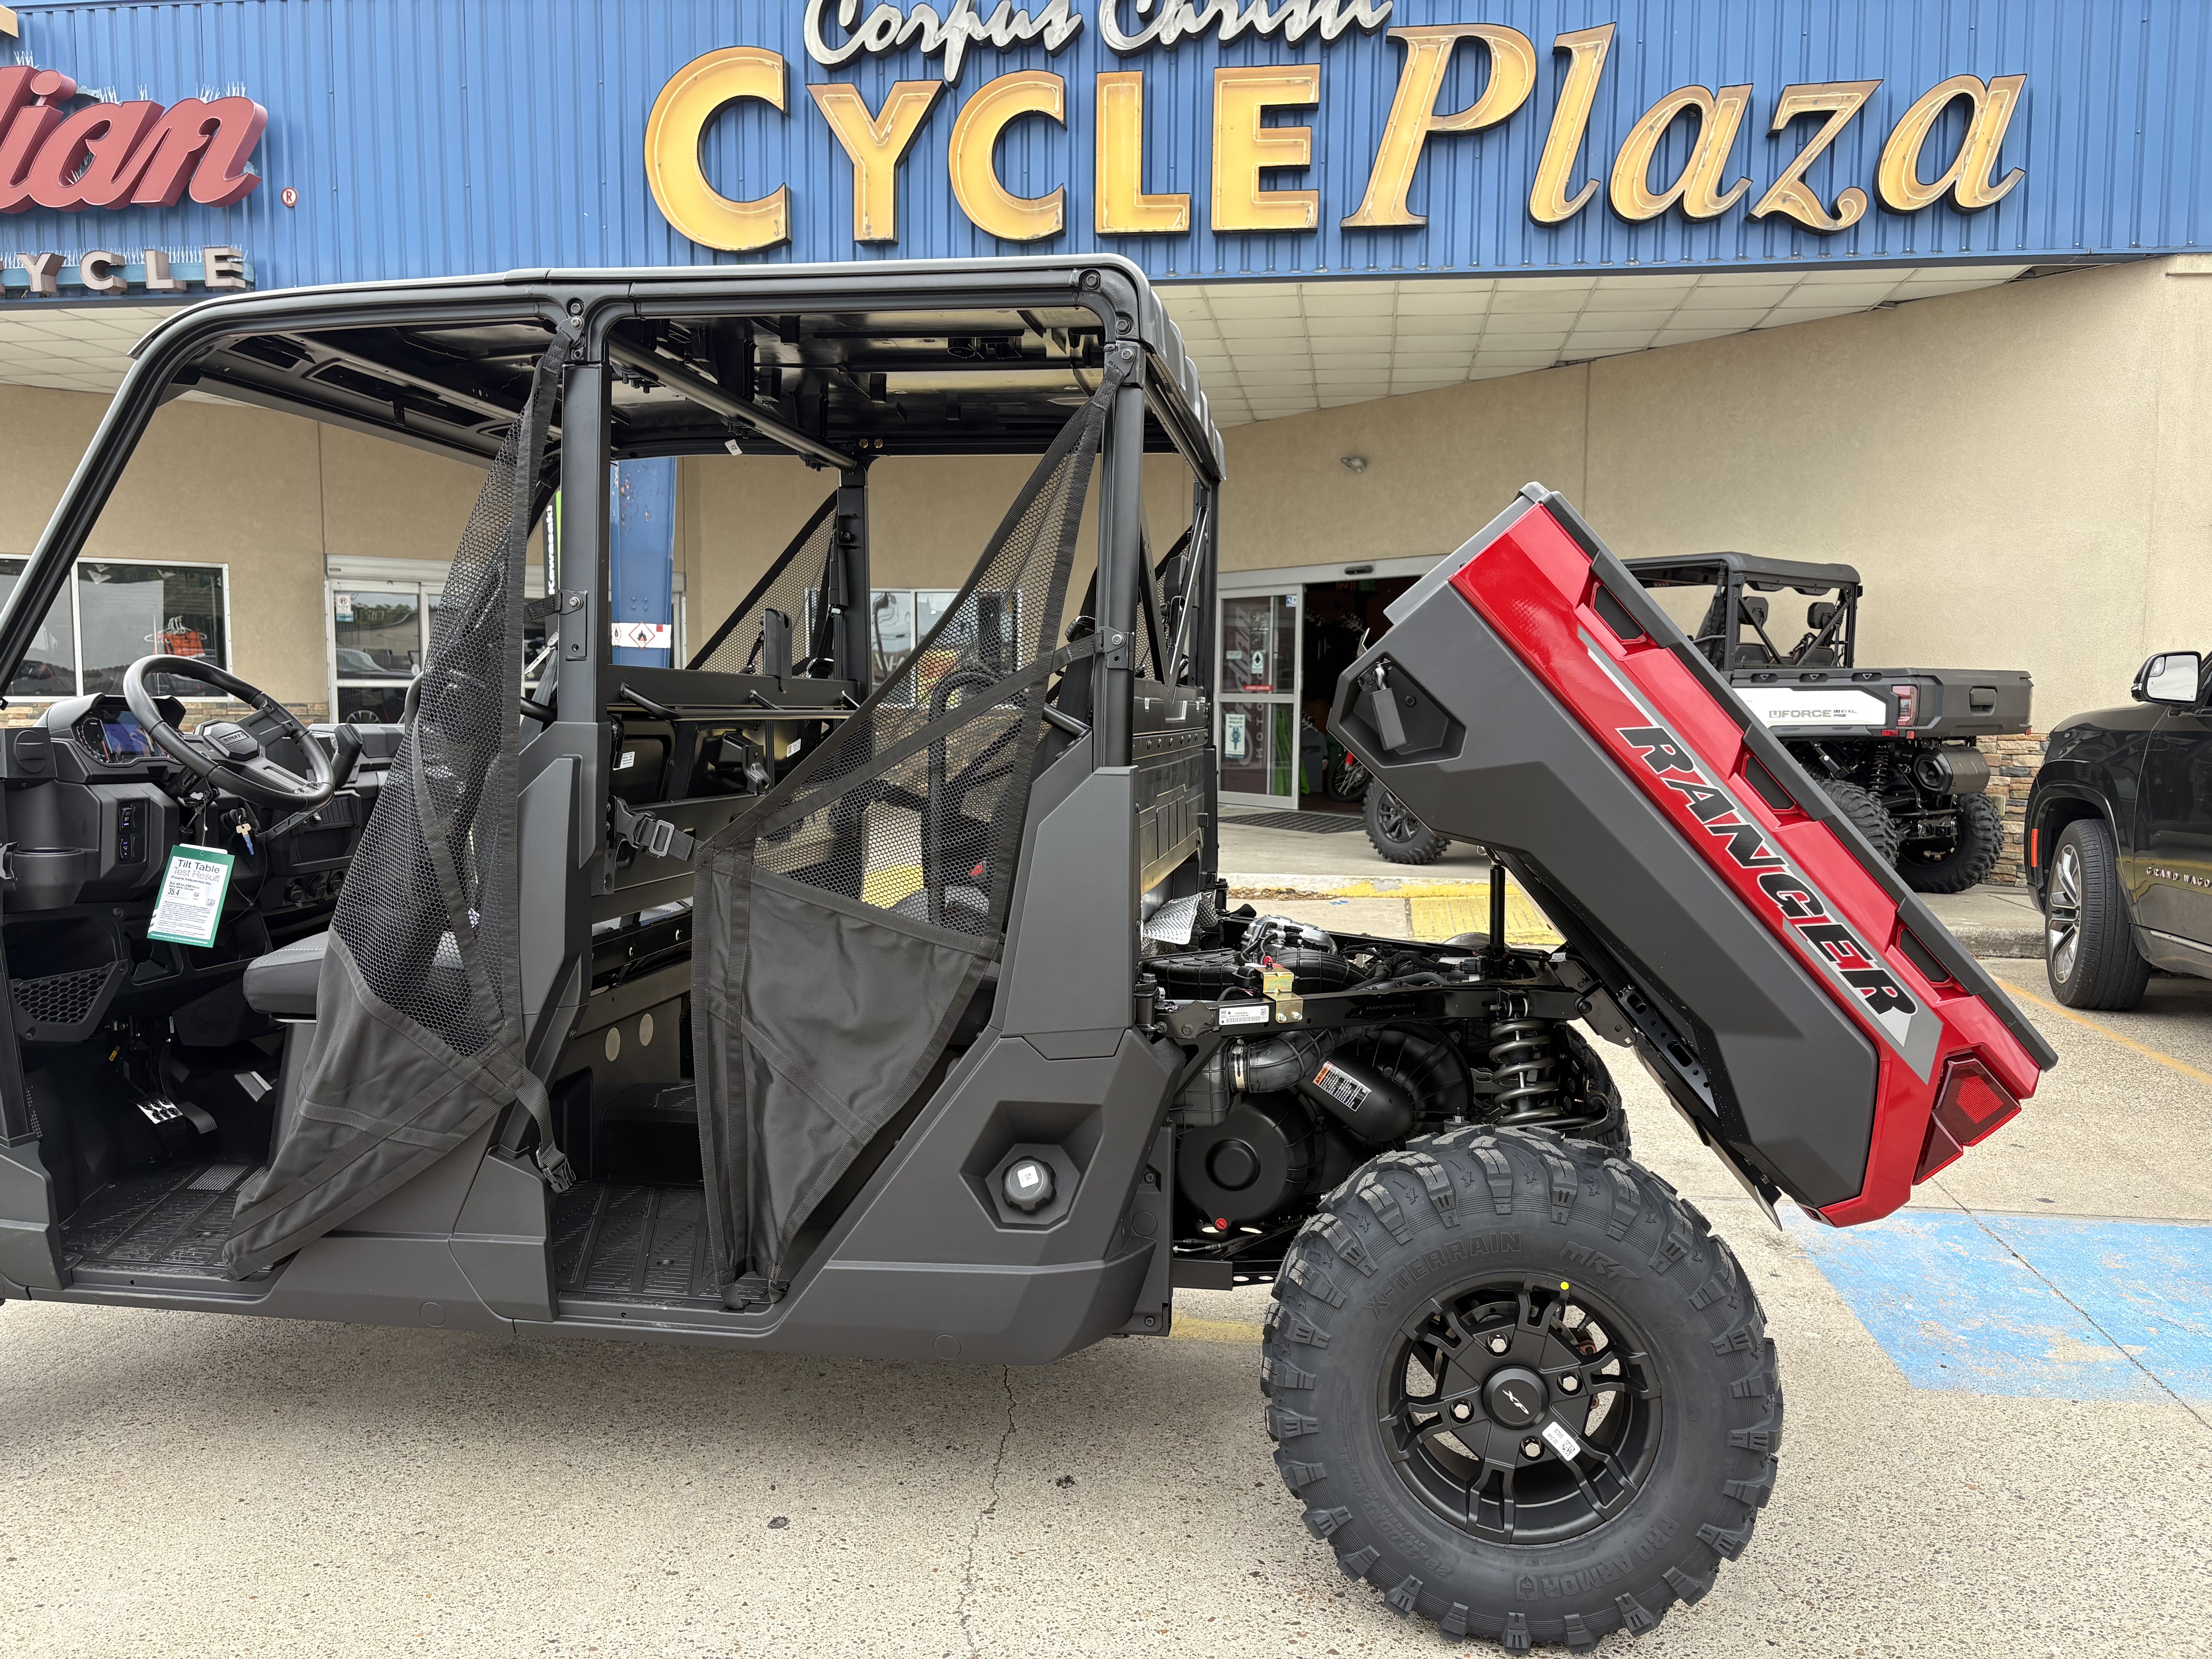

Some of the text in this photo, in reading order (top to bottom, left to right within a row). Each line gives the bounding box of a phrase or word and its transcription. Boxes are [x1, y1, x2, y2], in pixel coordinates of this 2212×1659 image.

[644, 22, 2028, 254] CYCLE Plaza
[0, 246, 246, 294] YCLE
[546, 505, 555, 595] Kawasaki
[174, 867, 190, 876] Test
[178, 859, 220, 874] Tilt Table
[1616, 726, 1918, 1016] RANGER
[2146, 867, 2212, 888] GRAND WAGO
[1362, 1232, 1522, 1318] X-TERRAIN
[1502, 1389, 1529, 1415] XP
[1542, 1515, 1681, 1598] PRO ARMOR
